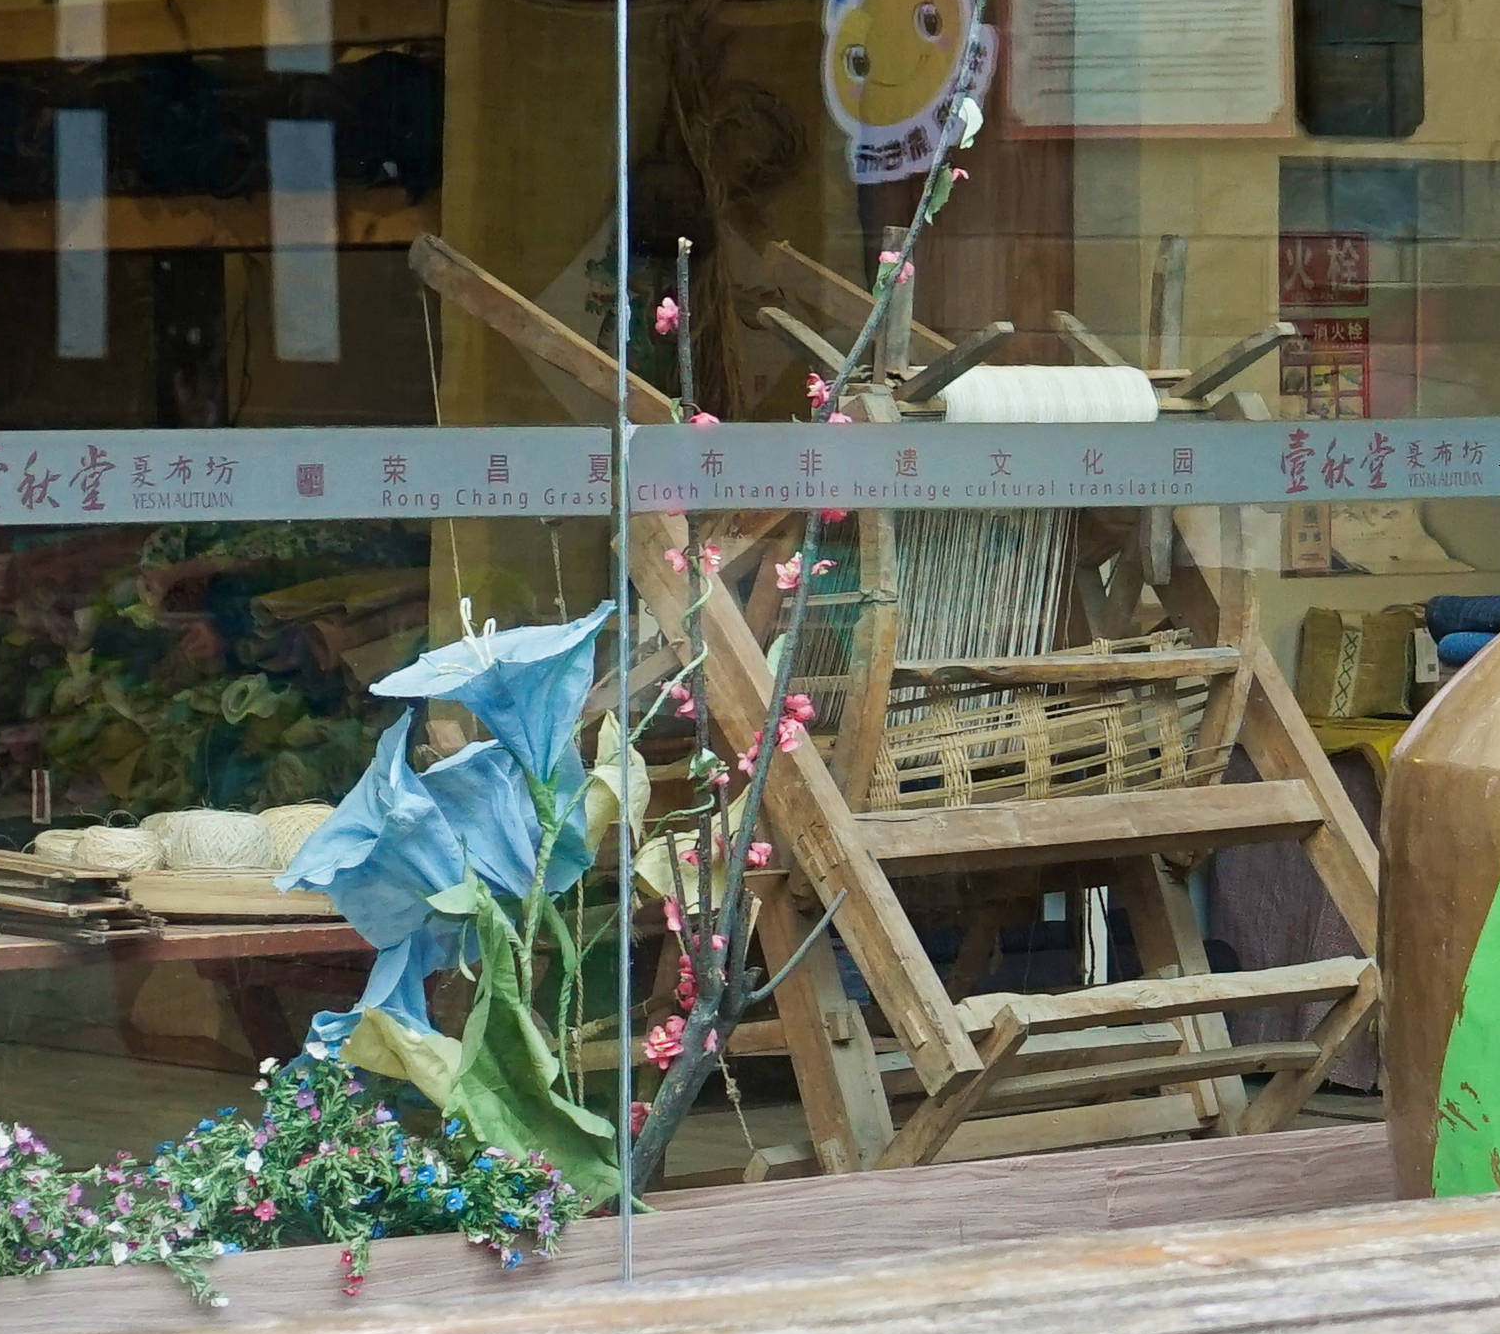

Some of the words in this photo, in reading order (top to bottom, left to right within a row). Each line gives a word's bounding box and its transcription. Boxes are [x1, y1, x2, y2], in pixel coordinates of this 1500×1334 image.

[1313, 322, 1363, 341] 消火栓
[1405, 439, 1488, 469] 夏布坊
[131, 454, 240, 487] 夏布坊
[175, 492, 233, 509] AUTUMN
[381, 489, 440, 512] Rong
[455, 486, 528, 510] Chang
[543, 485, 607, 503] Grass
[636, 482, 698, 501] Cloth
[714, 481, 839, 502] Intangible
[853, 480, 951, 501] heritage
[964, 479, 1055, 497] cultural
[1068, 477, 1193, 496] translation
